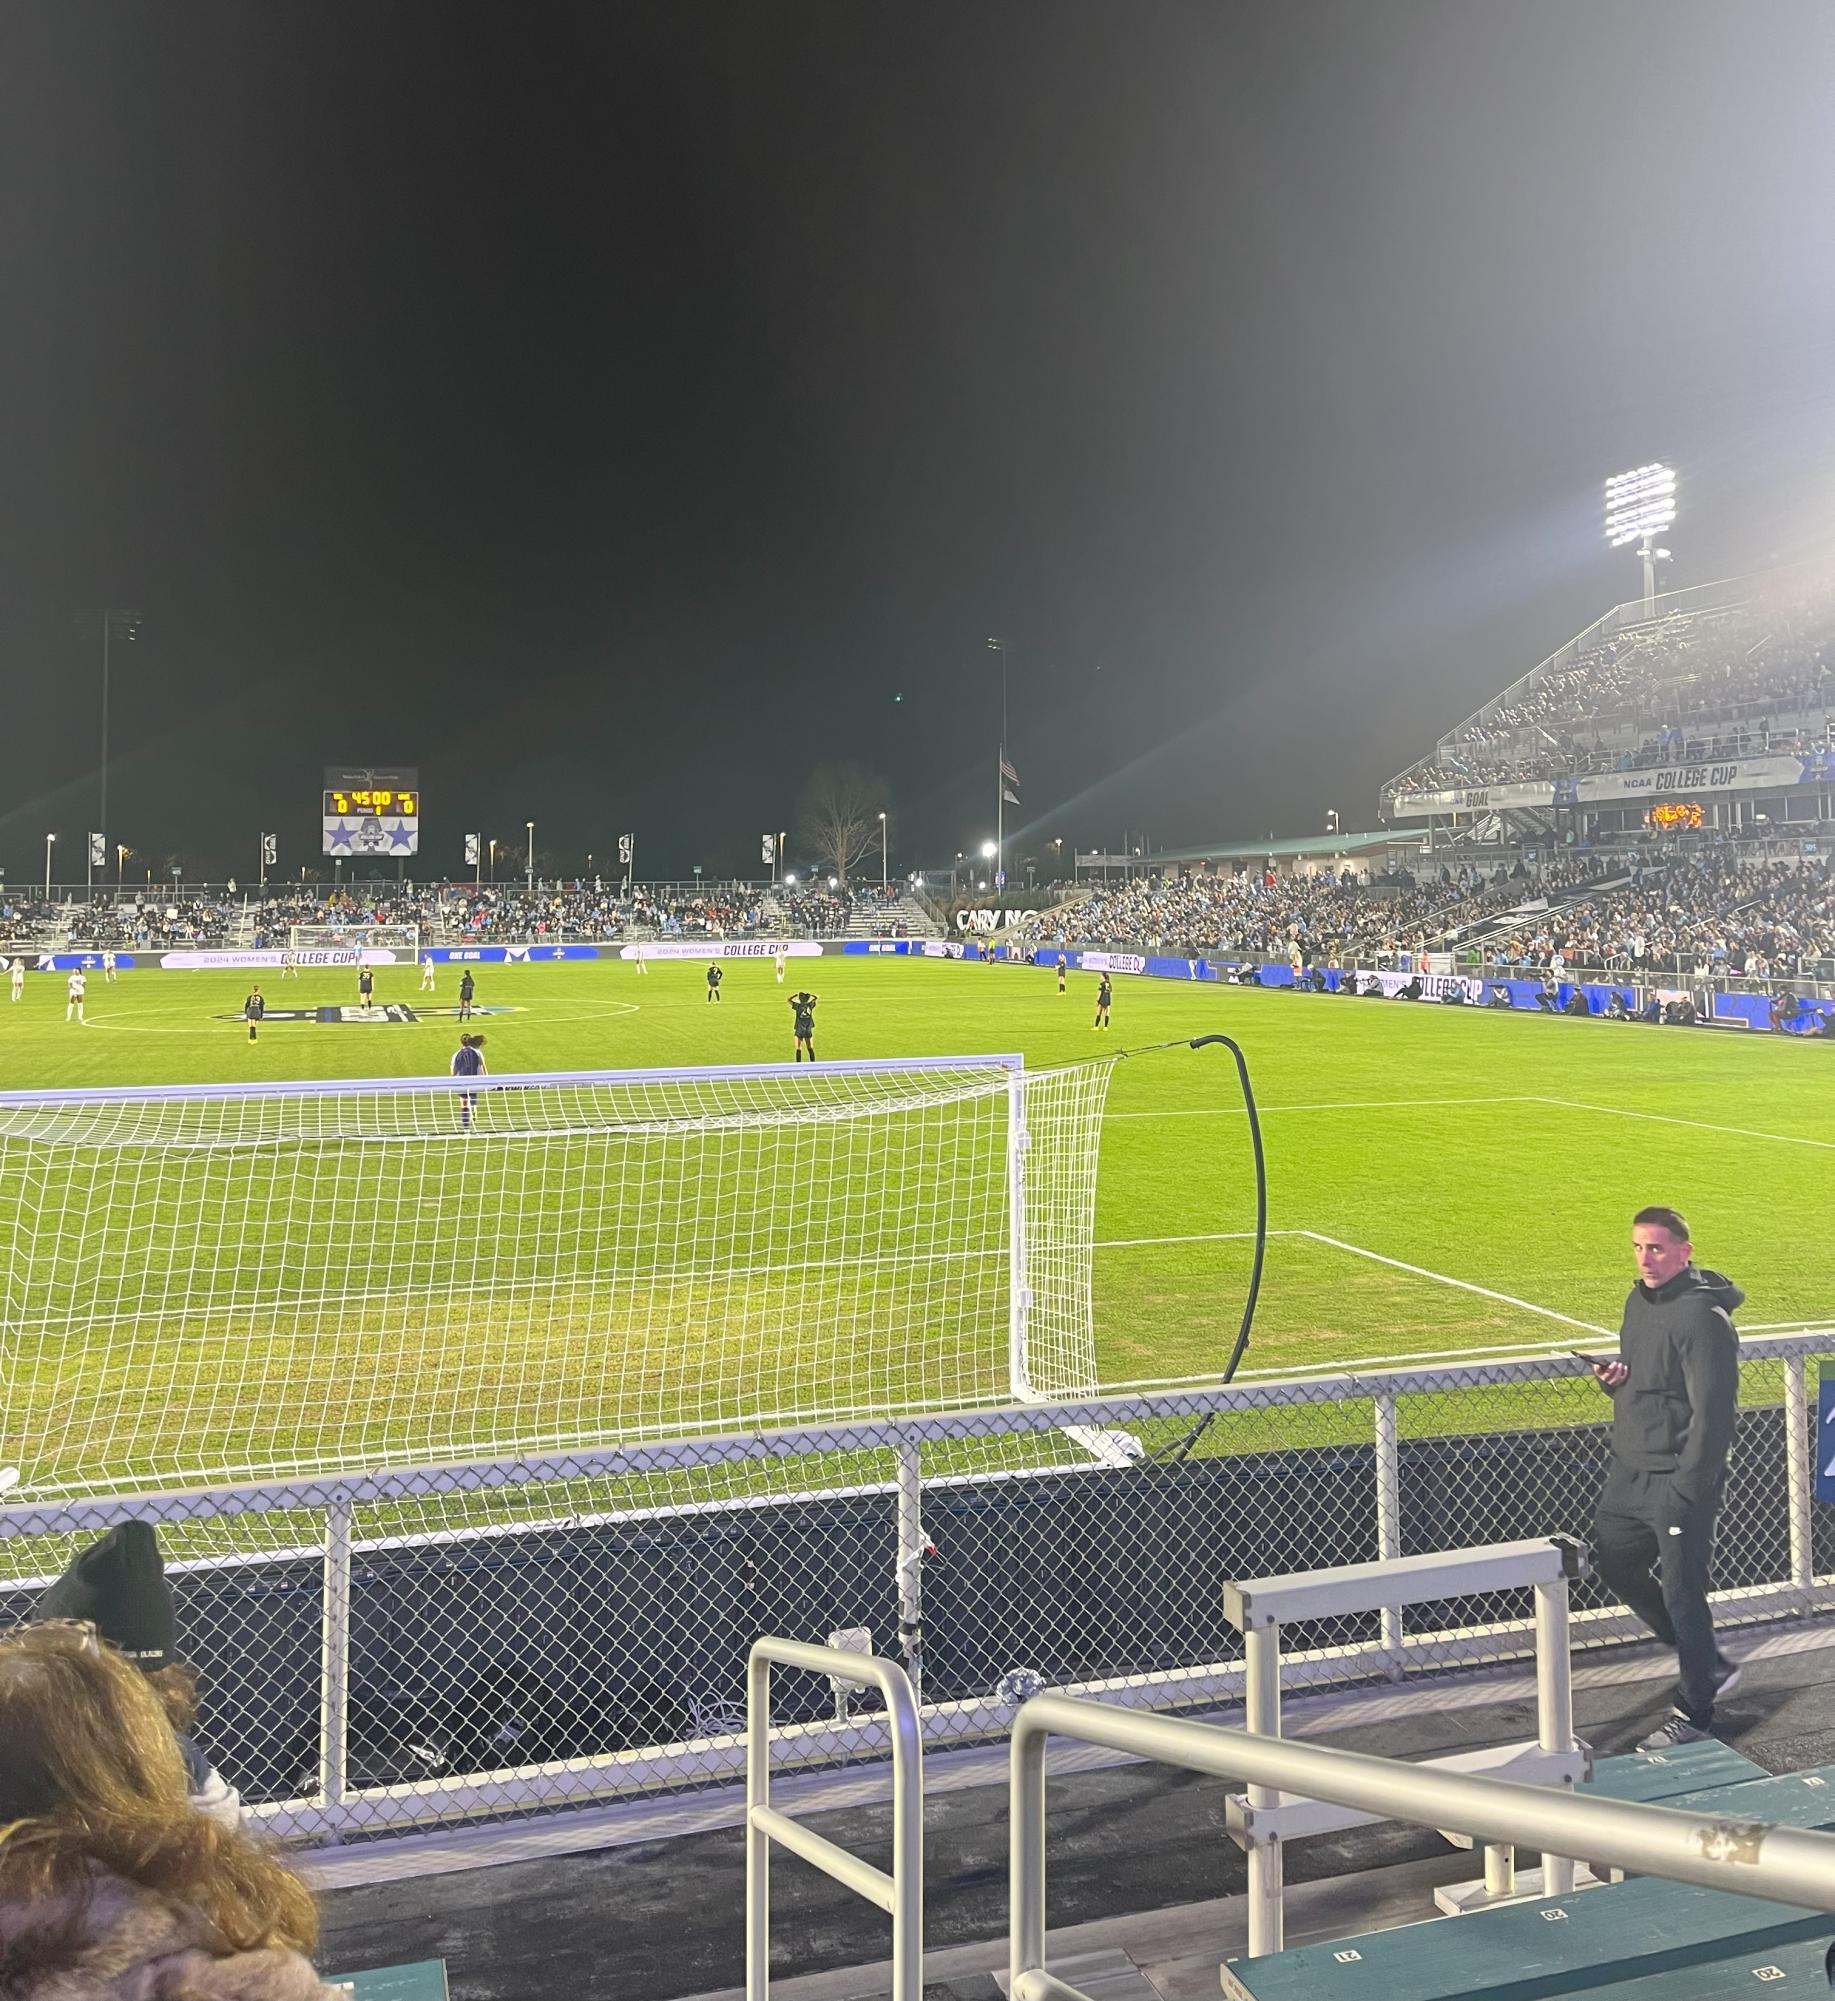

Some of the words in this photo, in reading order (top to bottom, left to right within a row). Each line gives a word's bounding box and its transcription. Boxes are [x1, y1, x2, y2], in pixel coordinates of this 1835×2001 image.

[1623, 779, 1652, 789] NCAA
[1655, 768, 1708, 791] COLLEGE
[1710, 765, 1738, 786] CUP
[1466, 791, 1489, 808] GOAL
[956, 909, 1001, 932] CARY
[723, 945, 766, 956] COLLEGE
[1757, 1967, 1781, 1980] 20
